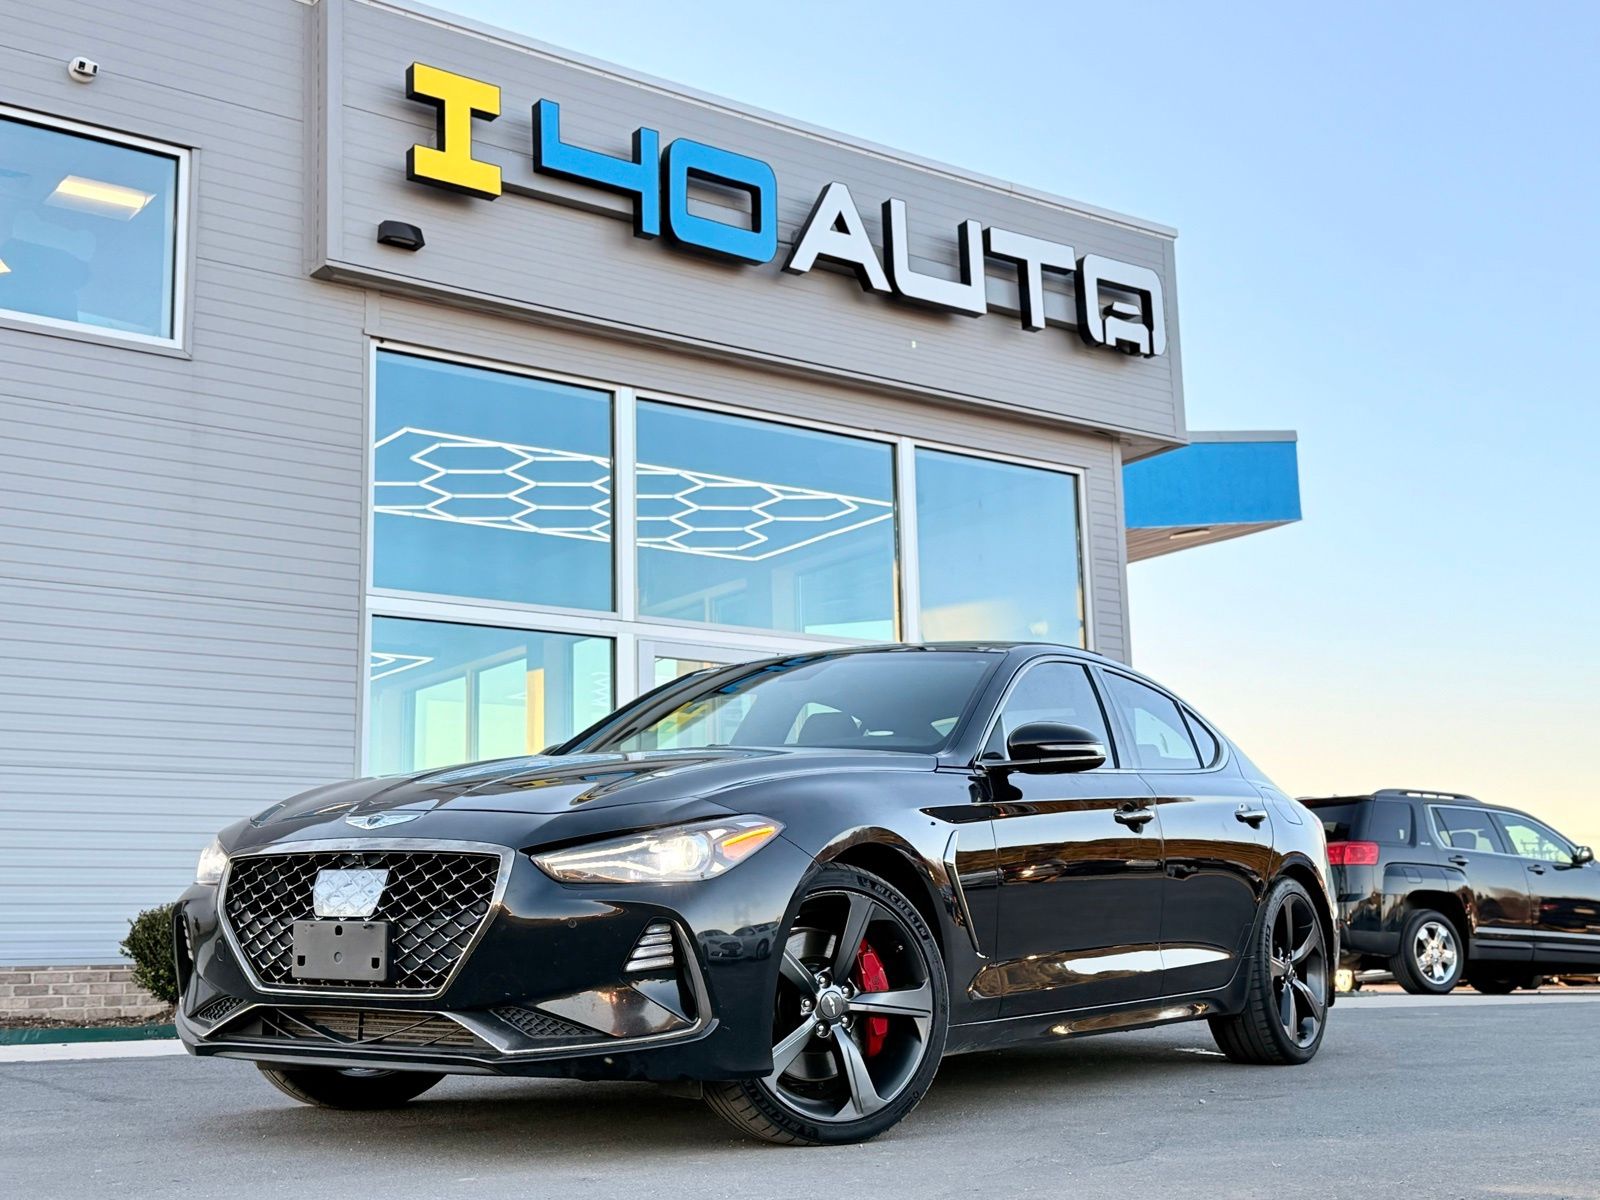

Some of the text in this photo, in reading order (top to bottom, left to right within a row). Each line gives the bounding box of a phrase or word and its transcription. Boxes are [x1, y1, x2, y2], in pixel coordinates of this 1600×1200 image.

[407, 62, 1167, 358] I 40 AUTO
[873, 883, 928, 937] MICHELIN
